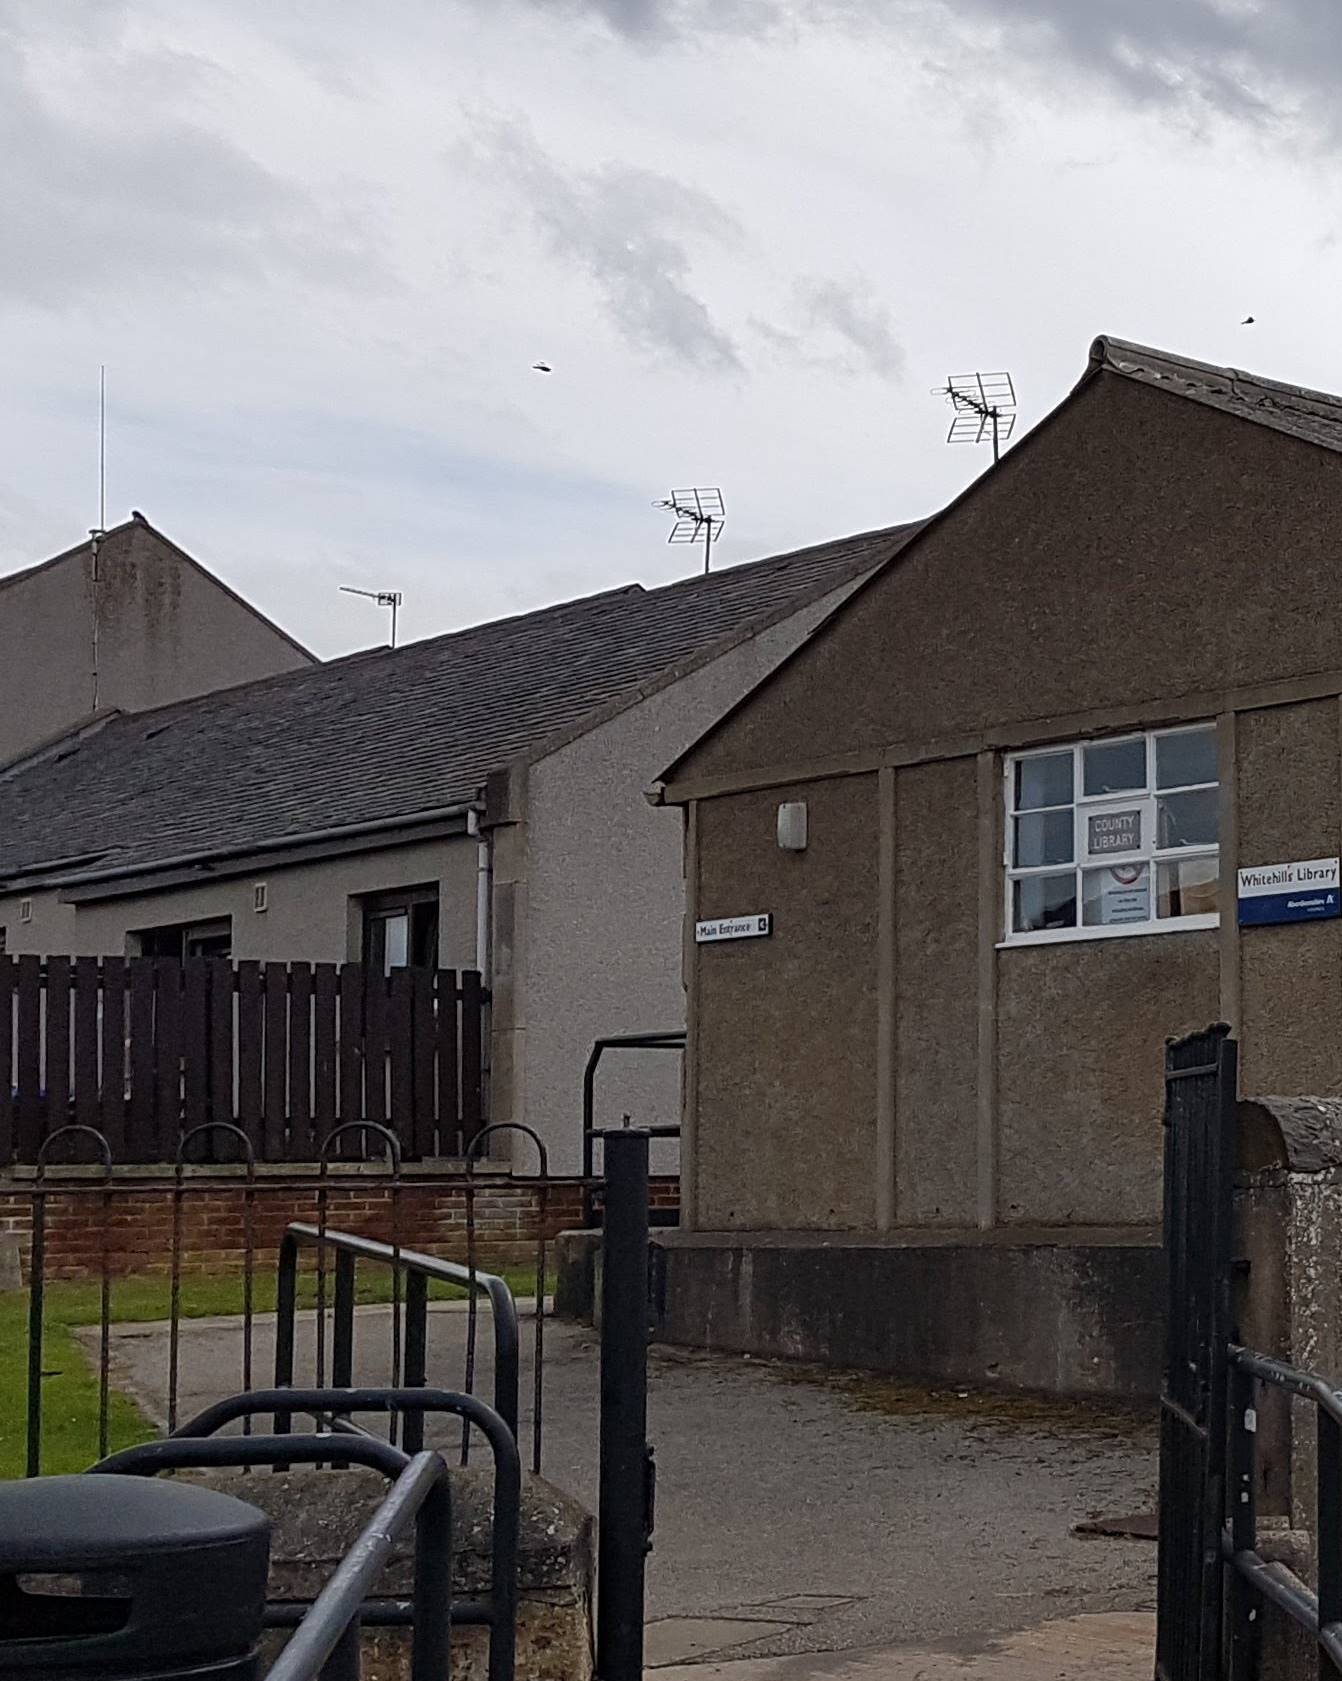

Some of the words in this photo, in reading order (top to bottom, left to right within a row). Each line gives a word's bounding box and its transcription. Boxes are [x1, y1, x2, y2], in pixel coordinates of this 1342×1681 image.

[1095, 816, 1135, 832] COUNTY
[1093, 833, 1135, 849] LIBRARY
[1240, 871, 1293, 886] Whitehills
[1297, 867, 1337, 881] Library
[700, 926, 717, 936] Main
[719, 924, 751, 935] Entrance
